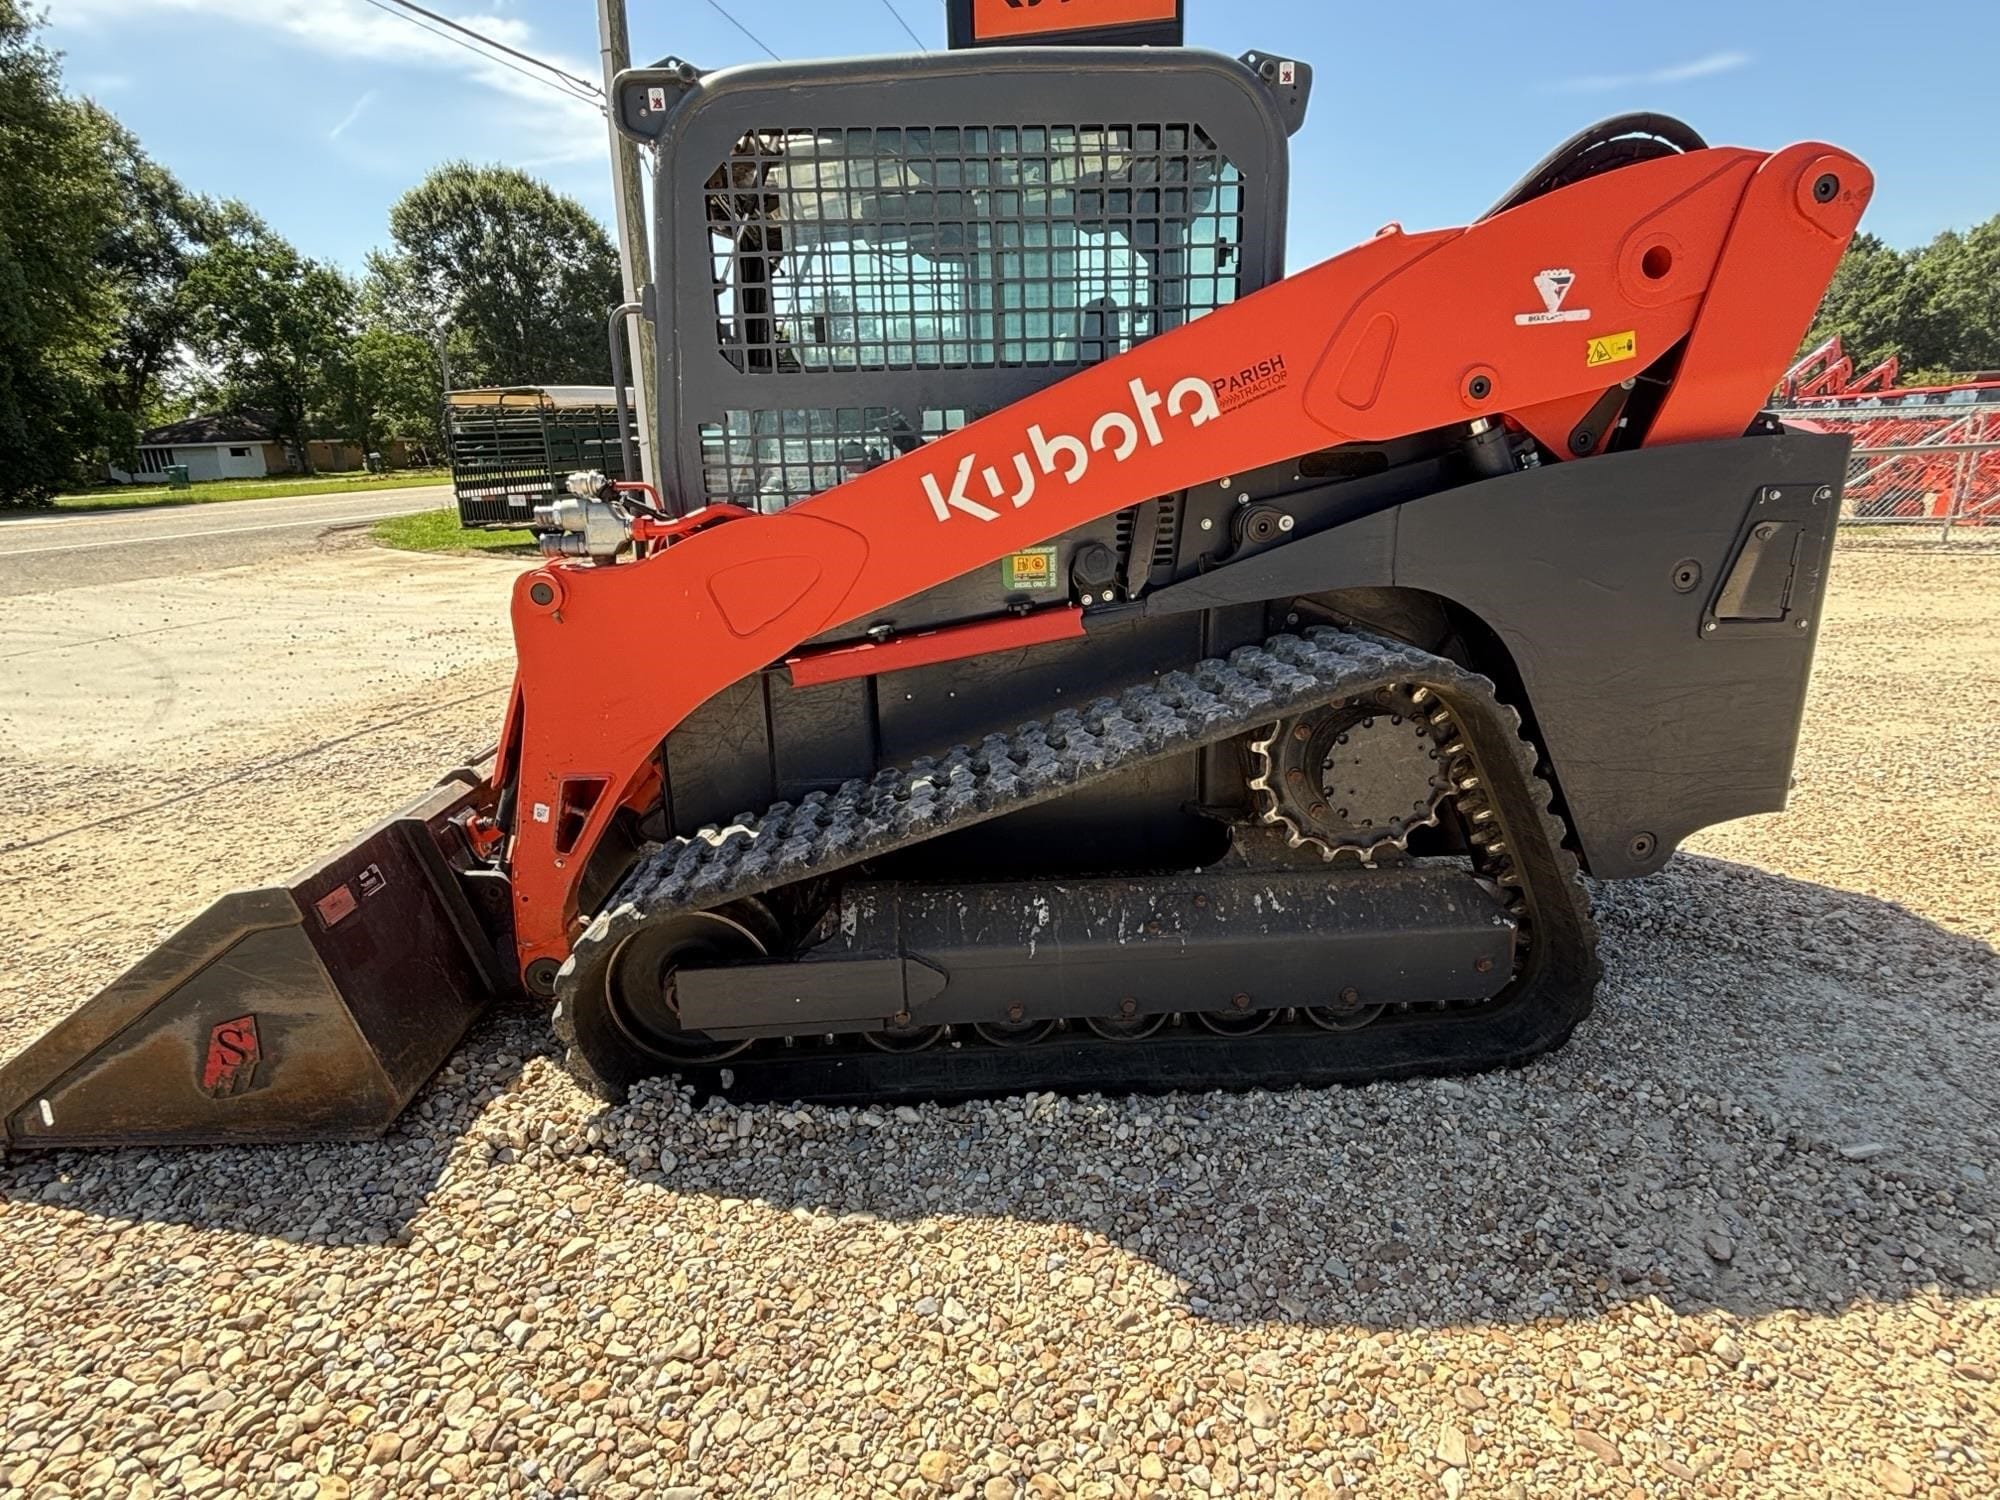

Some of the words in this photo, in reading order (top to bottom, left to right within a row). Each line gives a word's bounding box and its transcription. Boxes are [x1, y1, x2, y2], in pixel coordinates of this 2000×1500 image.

[1212, 354, 1285, 398] PARISH
[1238, 370, 1288, 399] TRACTOR
[920, 376, 1221, 522] Kubota
